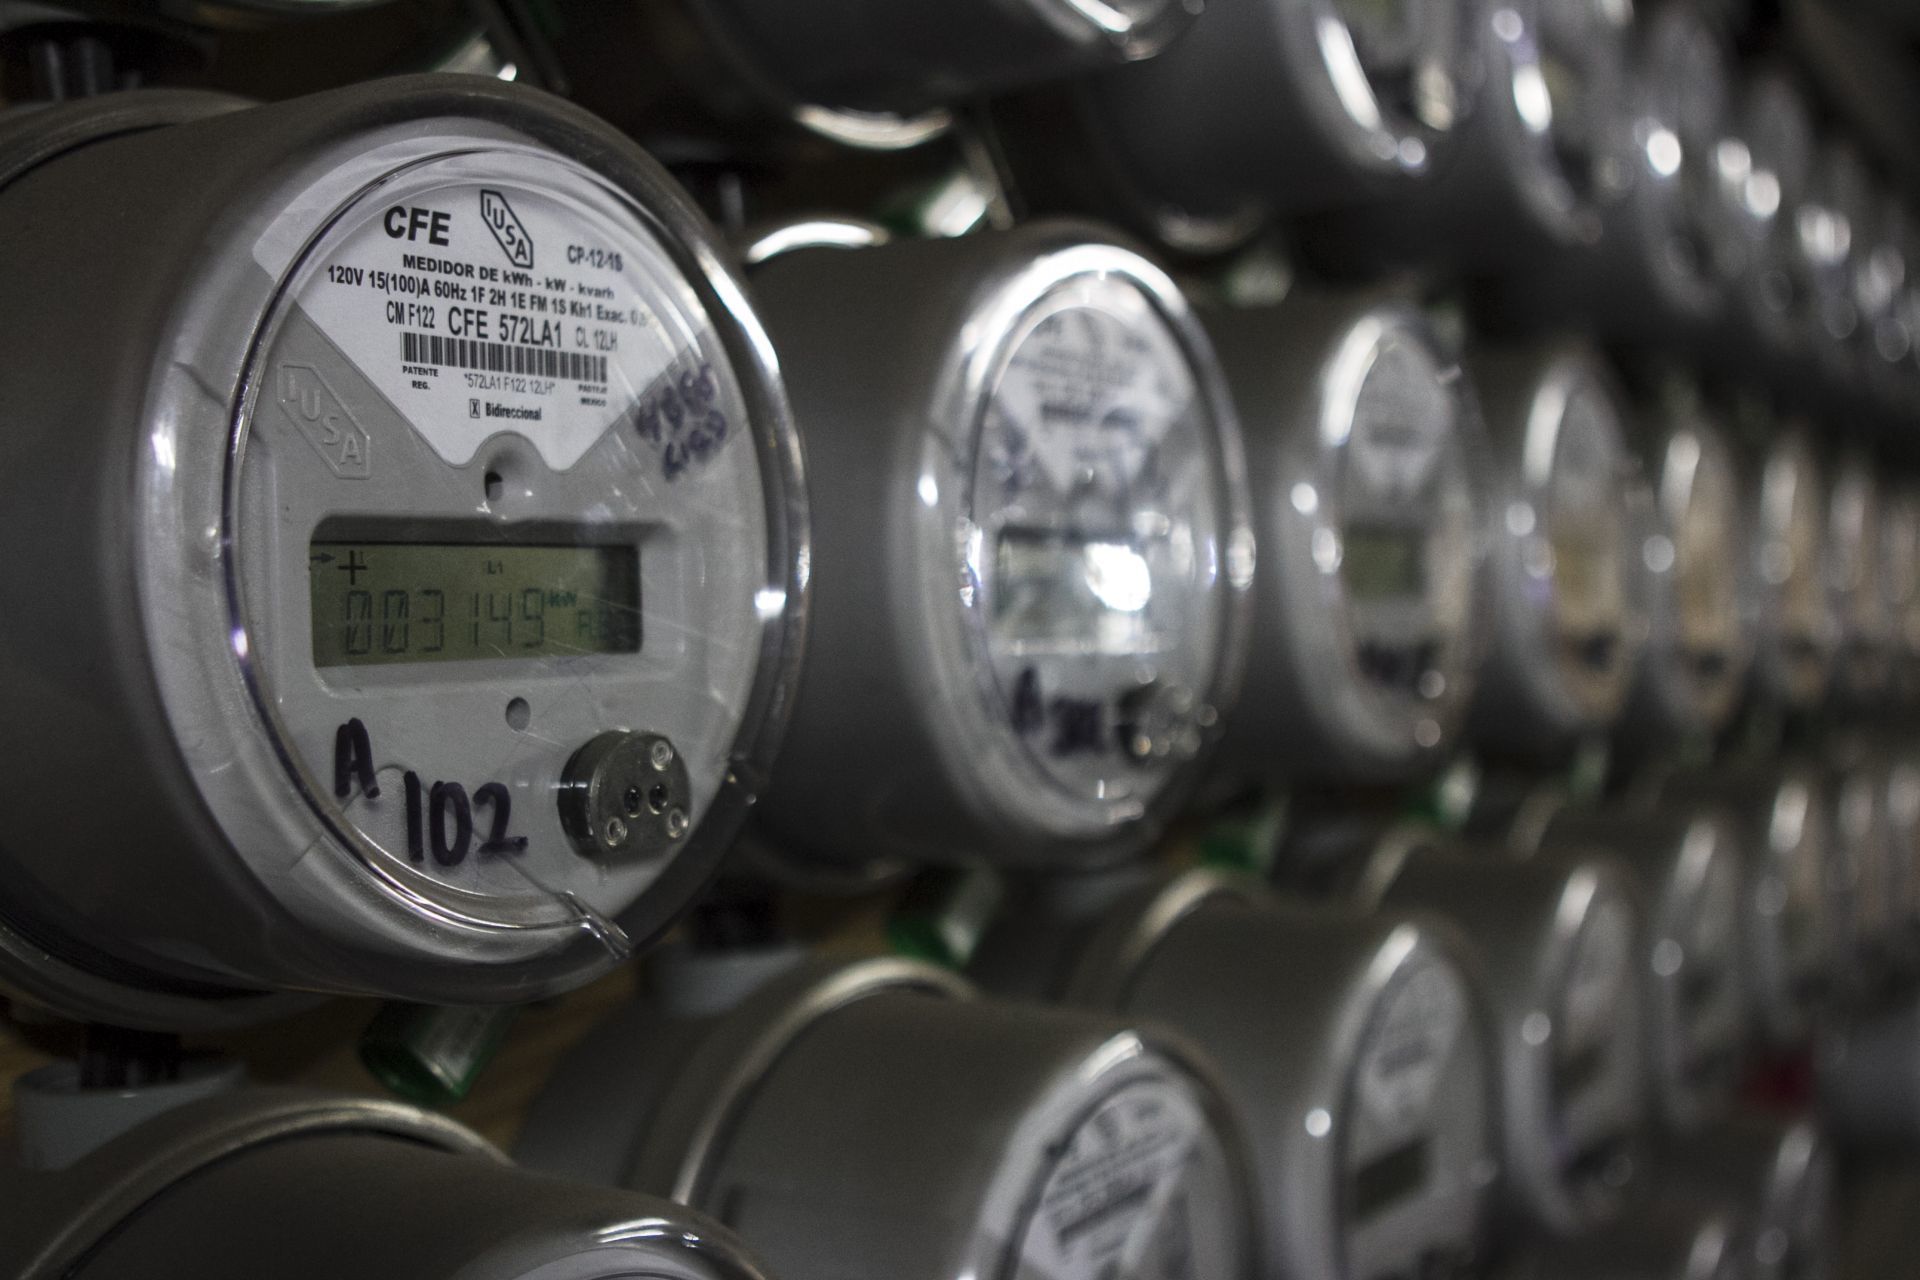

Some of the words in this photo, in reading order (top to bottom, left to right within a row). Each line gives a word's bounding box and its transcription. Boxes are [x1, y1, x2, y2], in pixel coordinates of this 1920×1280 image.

[384, 205, 451, 247] CFE
[486, 198, 528, 261] IUSA
[328, 265, 364, 287] 120V
[368, 270, 430, 299] 15(100)A
[434, 280, 467, 301] 60Hz
[471, 285, 485, 303] 1F
[489, 289, 506, 307] 2H
[511, 291, 526, 310] 1E
[530, 294, 547, 312] FM
[552, 299, 567, 315] 1S
[570, 300, 593, 318] Kh1
[402, 254, 475, 279] MEDIDOR
[479, 266, 498, 282] DE
[503, 270, 533, 287] kWh
[545, 277, 566, 292] kW
[386, 301, 405, 325] CM
[408, 303, 435, 329] F122
[448, 306, 489, 339] CFE
[499, 313, 562, 348] 572LA1
[576, 326, 589, 348] CL
[402, 365, 439, 377] PATENTE
[411, 380, 431, 390] REG.
[289, 374, 362, 466] IUSA
[485, 402, 542, 421] Bidireccional
[346, 588, 545, 654] 003149
[334, 717, 380, 799] A
[403, 770, 529, 867] 102
